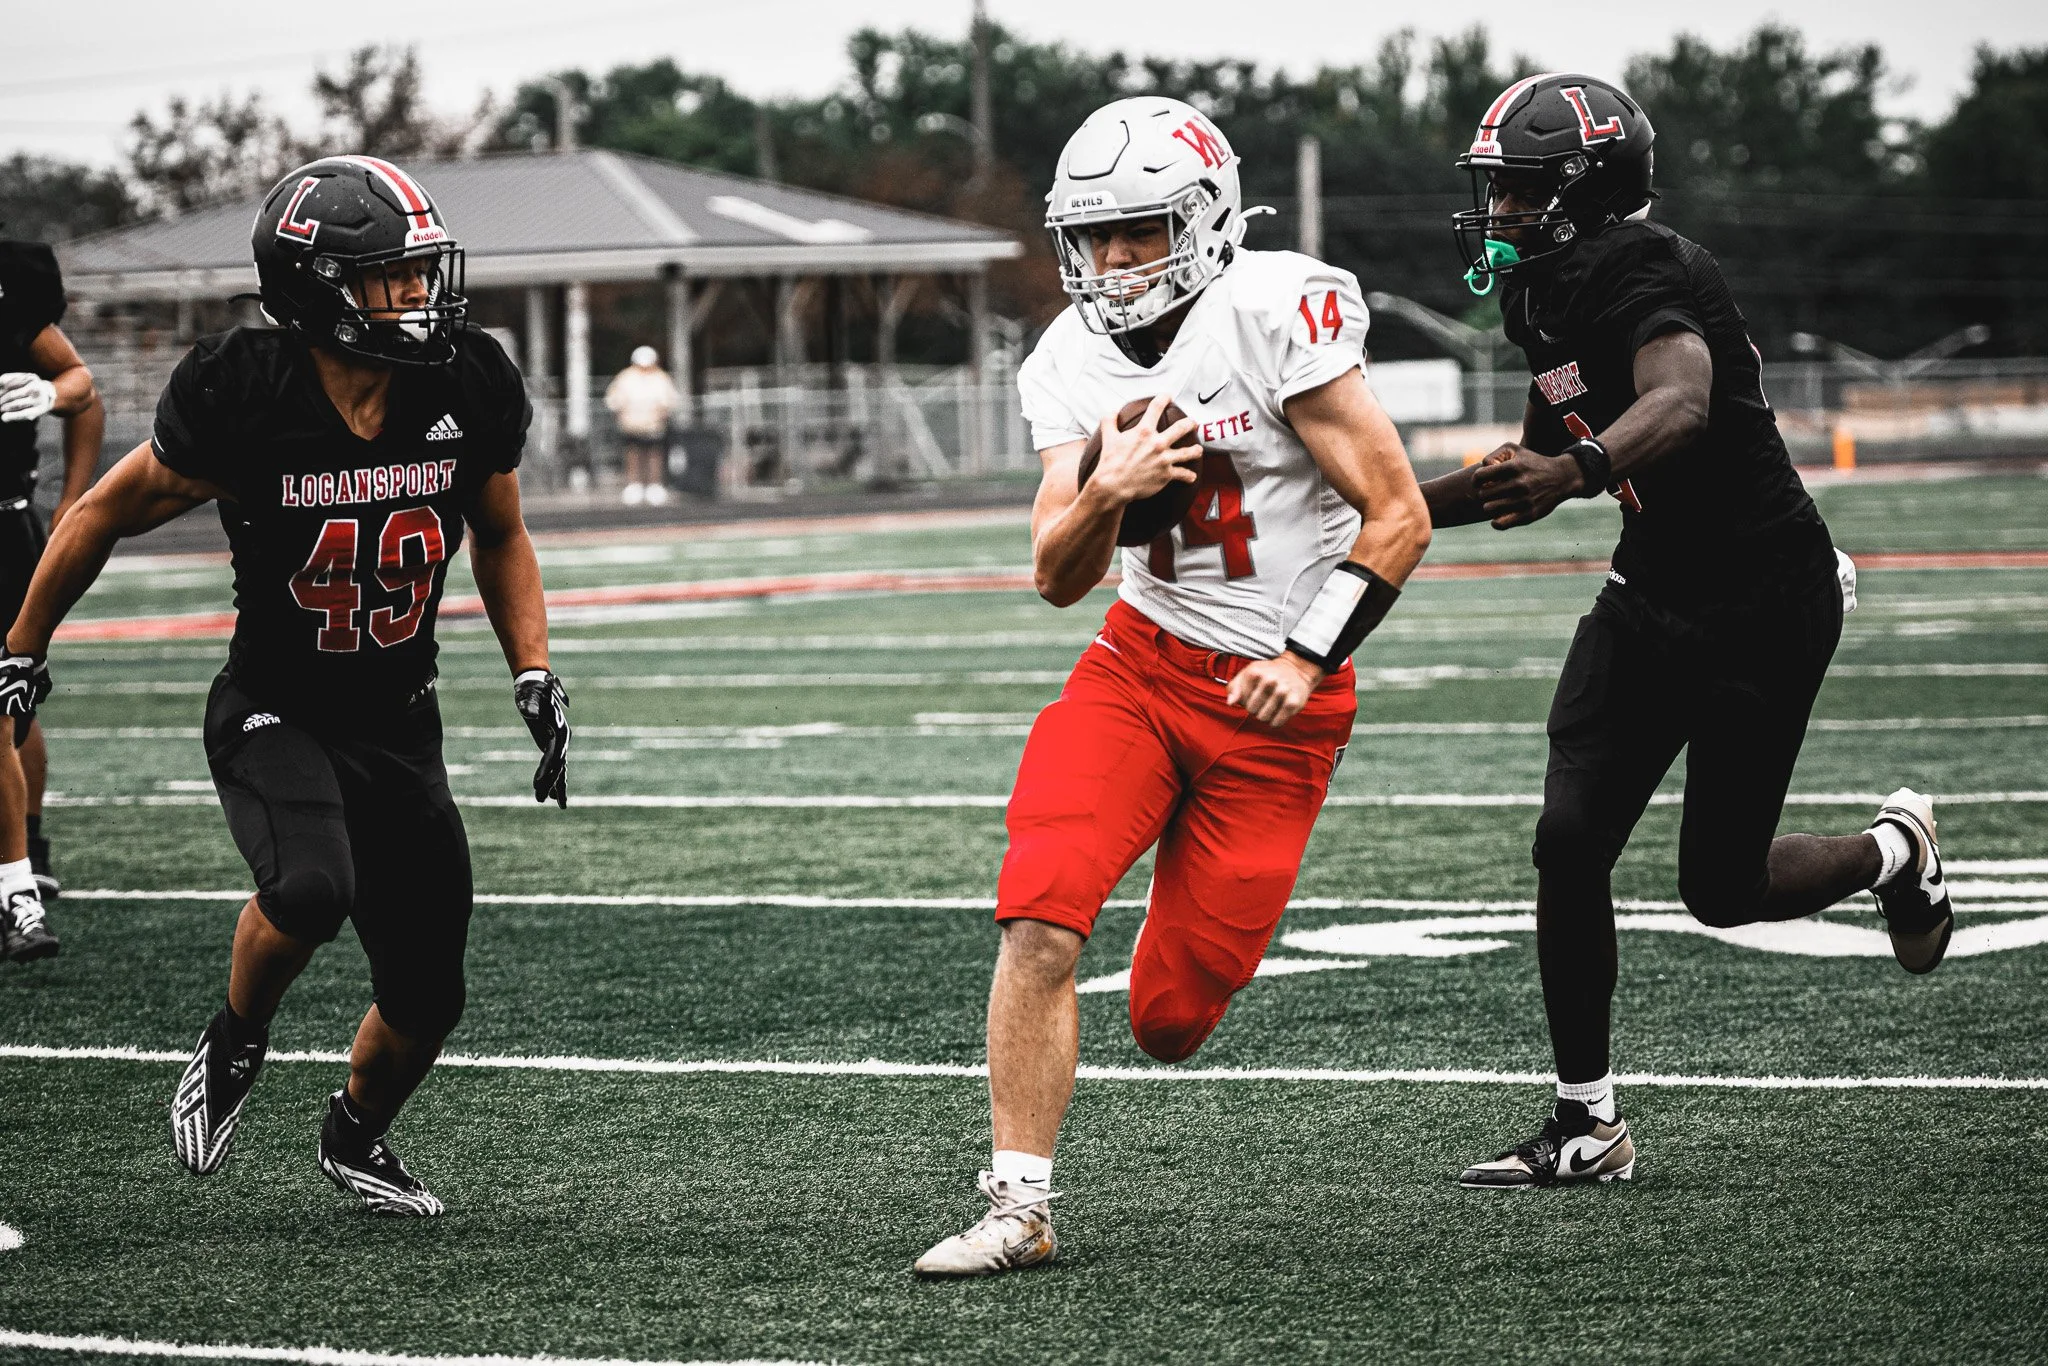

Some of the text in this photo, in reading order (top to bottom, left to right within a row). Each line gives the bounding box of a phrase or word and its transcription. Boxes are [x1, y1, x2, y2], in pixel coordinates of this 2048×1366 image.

[276, 175, 321, 245] L
[1071, 196, 1103, 208] DEVILS
[413, 231, 444, 242] Riddell
[1298, 290, 1343, 344] 14
[426, 429, 463, 441] adidas
[282, 459, 457, 507] LOGANSPORT
[289, 505, 446, 652] 49
